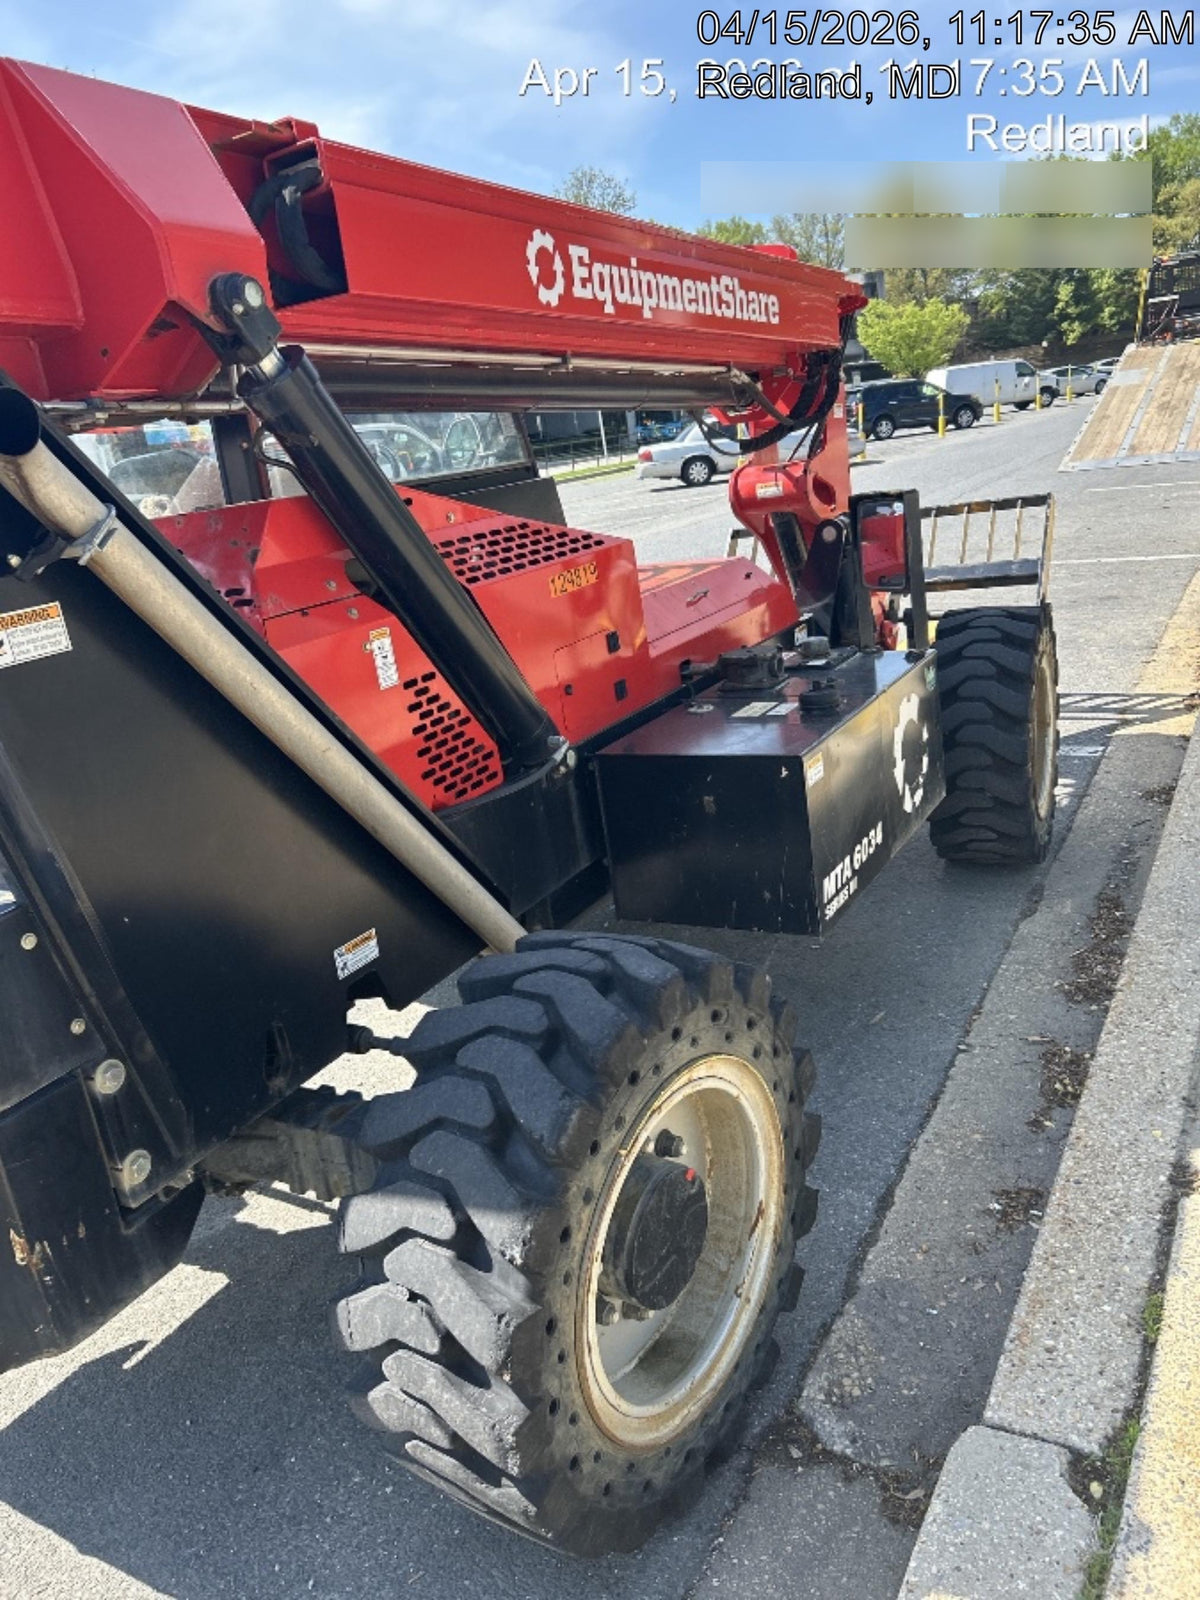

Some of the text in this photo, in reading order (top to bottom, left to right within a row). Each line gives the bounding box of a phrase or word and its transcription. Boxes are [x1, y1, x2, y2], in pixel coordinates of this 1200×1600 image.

[568, 244, 780, 325] EquipmentShare
[823, 821, 883, 904] MTA 6034
